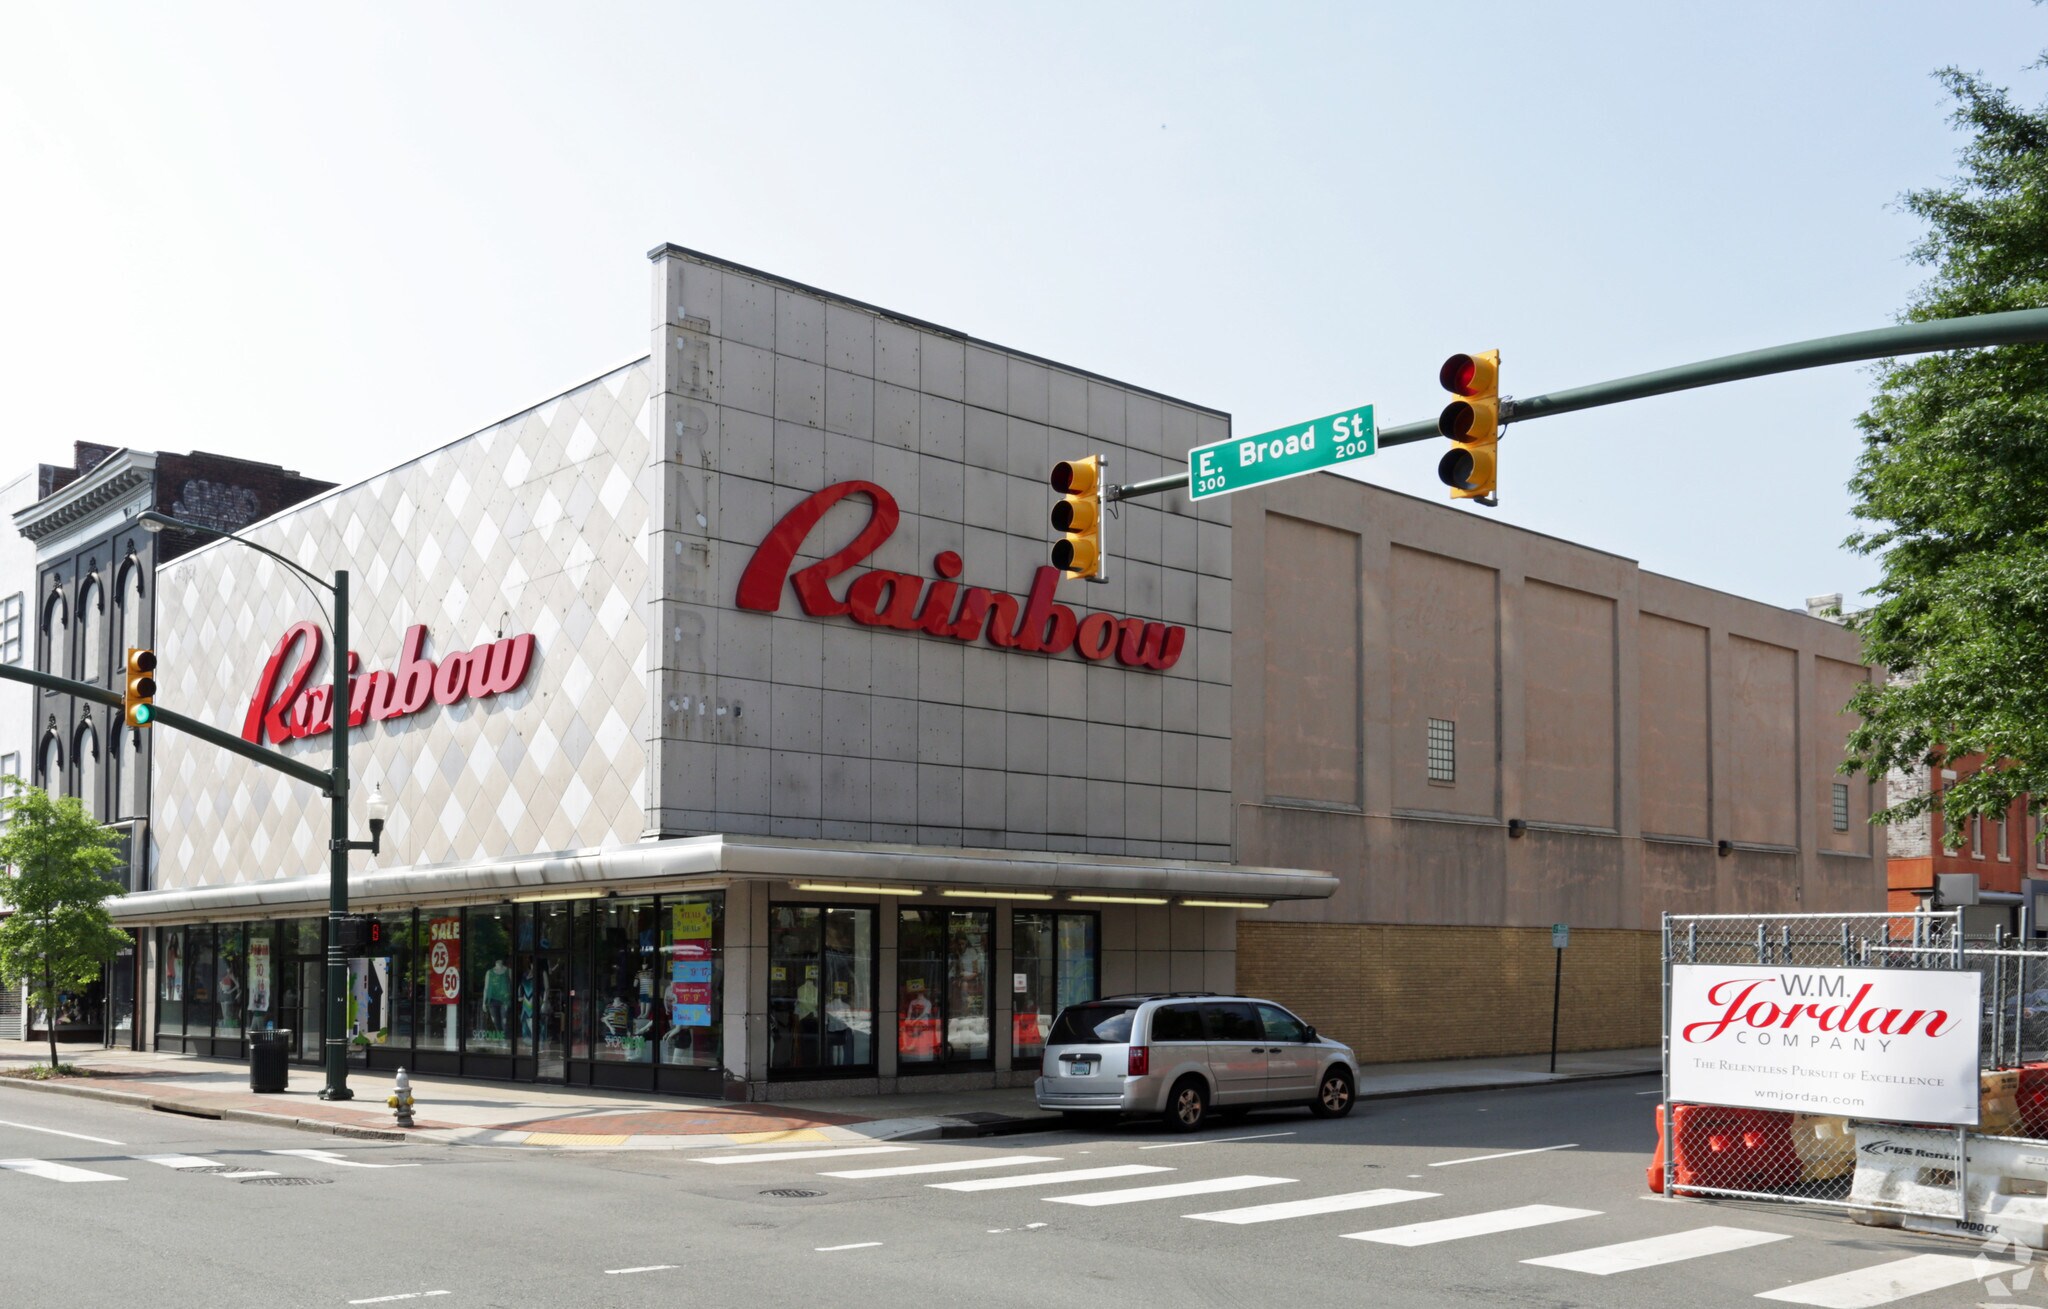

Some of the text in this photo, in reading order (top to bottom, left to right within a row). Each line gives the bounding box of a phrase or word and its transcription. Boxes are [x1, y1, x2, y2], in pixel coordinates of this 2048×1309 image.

[1199, 413, 1364, 477] E. Broad St
[1335, 440, 1367, 459] 200
[1198, 475, 1226, 493] 300
[735, 480, 1186, 670] Rainbow
[431, 921, 460, 940] SALE
[433, 951, 446, 968] 25
[444, 973, 457, 992] 50
[1780, 973, 1851, 998] W.M.
[1682, 978, 1962, 1043] Jordan
[1736, 1031, 1891, 1053] COMPANY
[1754, 1088, 1865, 1106] wmjordan.com
[1884, 1145, 1972, 1163] PBS Rentas
[1955, 1219, 1999, 1234] YODOCK
